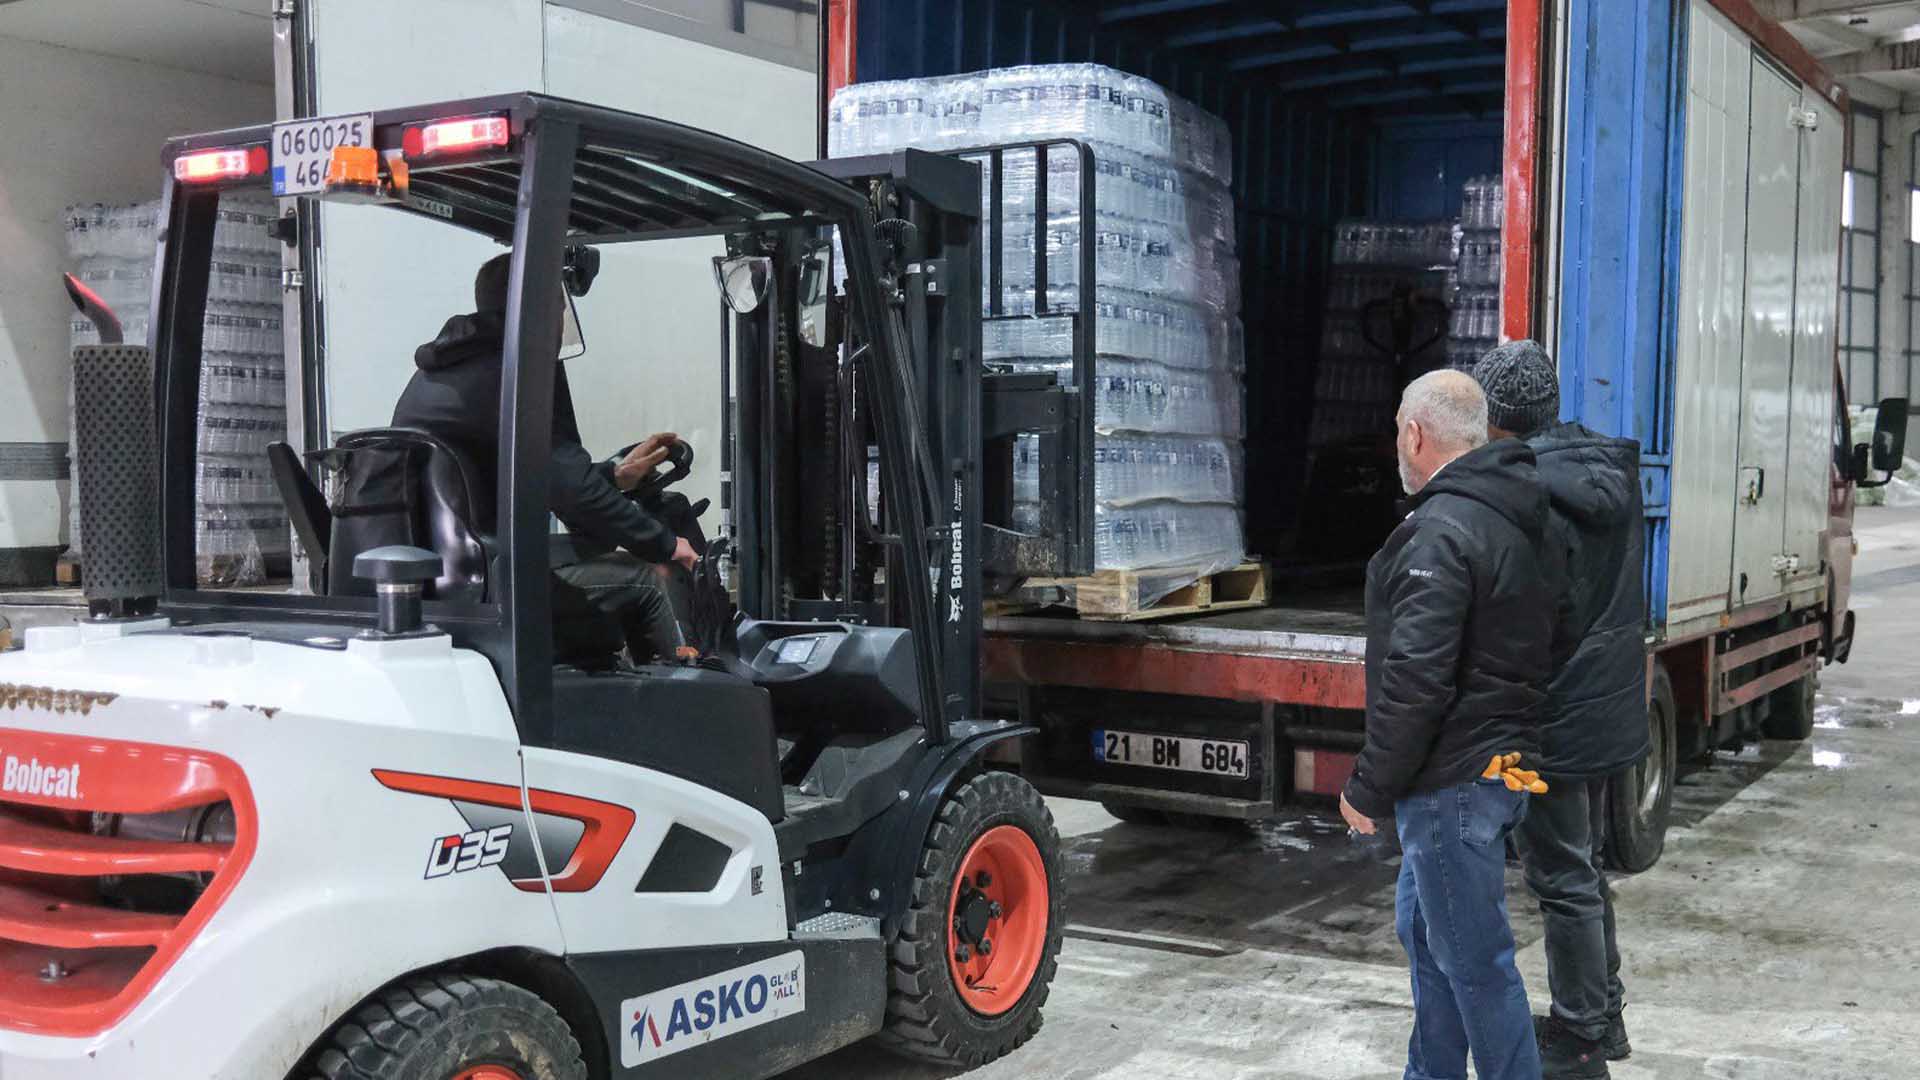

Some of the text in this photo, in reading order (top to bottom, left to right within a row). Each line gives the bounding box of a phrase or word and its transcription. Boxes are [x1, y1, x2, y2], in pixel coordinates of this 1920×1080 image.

[281, 121, 362, 156] 060025
[950, 520, 963, 589] Bobcat
[2, 755, 81, 800] Bobcat
[1106, 733, 1244, 773] 21 BM 684
[424, 823, 514, 880] D35
[665, 974, 768, 1042] ASKO
